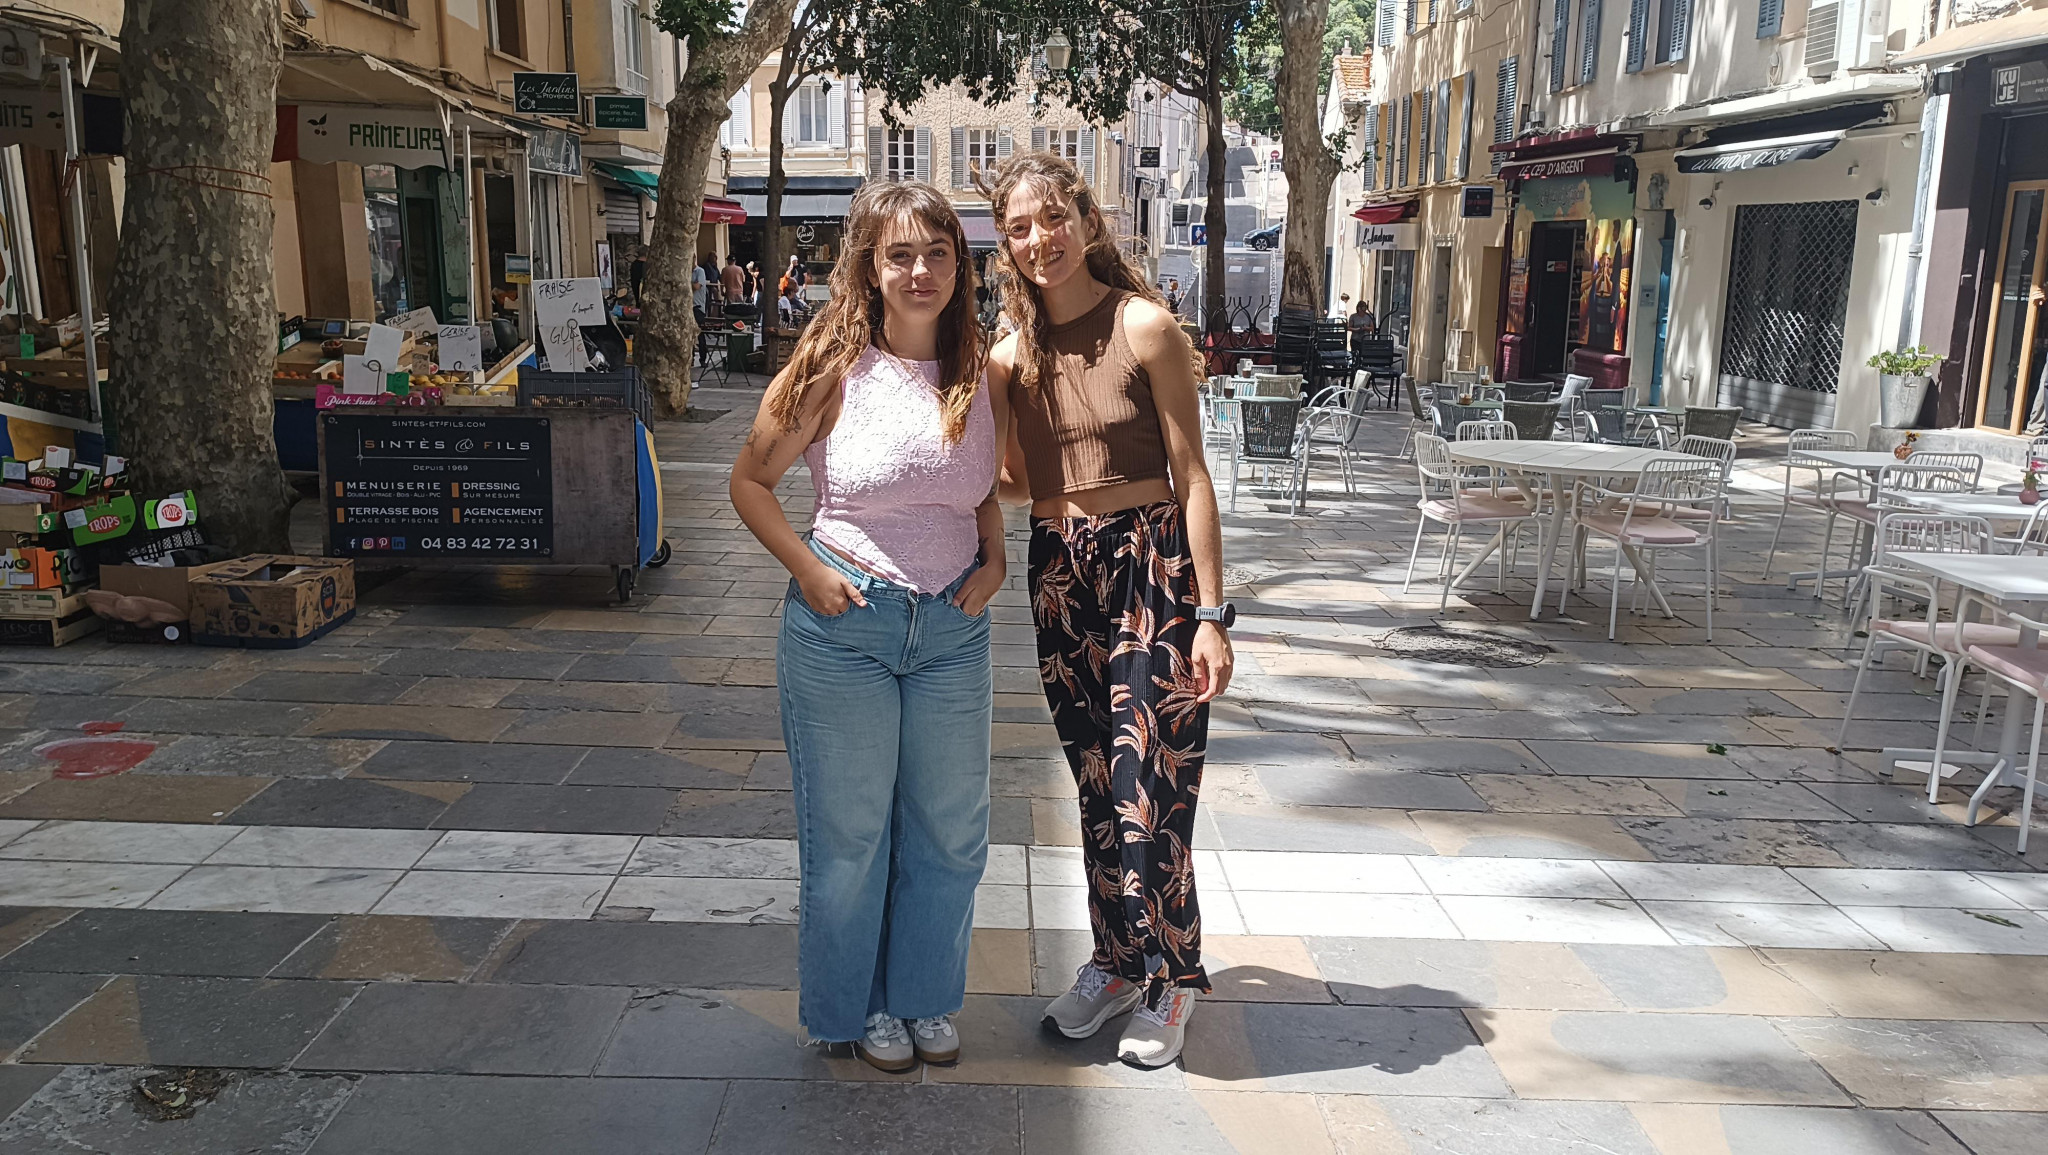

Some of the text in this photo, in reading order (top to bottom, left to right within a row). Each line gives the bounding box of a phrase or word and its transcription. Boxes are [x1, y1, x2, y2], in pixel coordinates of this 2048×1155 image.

[1999, 69, 2017, 86] KU
[517, 76, 575, 95] Les Jardins
[542, 92, 574, 100] Provence
[1999, 85, 2015, 101] JE
[0, 100, 33, 128] iTS
[1518, 159, 1585, 177] LE CEP D'ARGENT
[538, 280, 575, 297] FRAISE
[324, 395, 352, 407] Pink
[364, 437, 445, 450] SINTÈS
[483, 441, 530, 451] FILS
[30, 476, 56, 488] TROPS
[346, 481, 441, 490] MENUISERIE
[462, 482, 520, 491] DRESSING
[162, 504, 182, 519] TROPS
[347, 507, 439, 516] TERRASSE BOIS
[464, 507, 544, 516] AGENCEMENT
[88, 515, 120, 532] TROPS
[421, 537, 537, 550] 04 83 42 72 31
